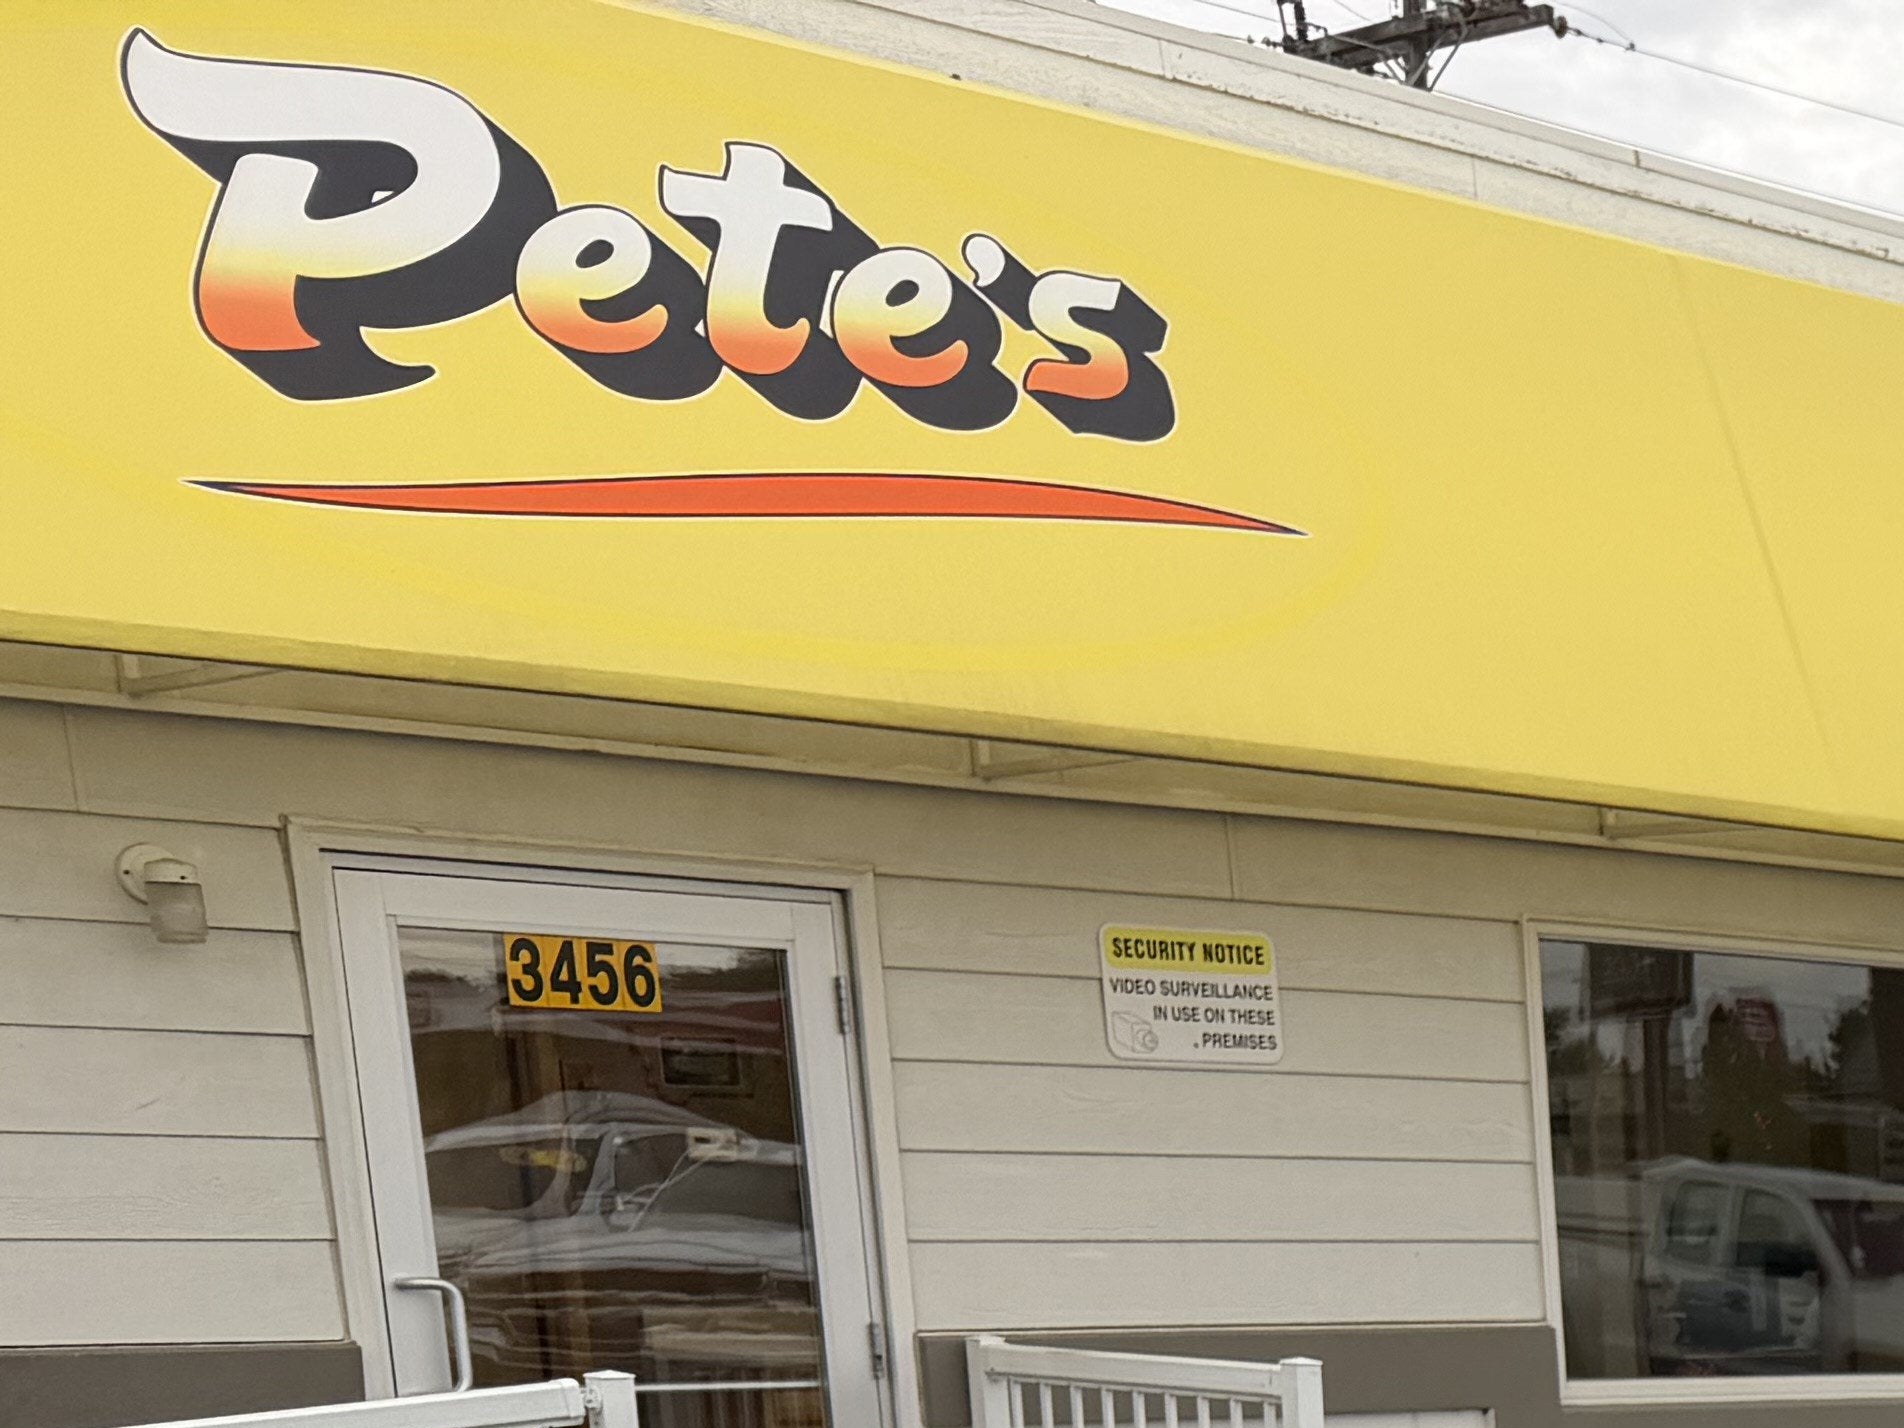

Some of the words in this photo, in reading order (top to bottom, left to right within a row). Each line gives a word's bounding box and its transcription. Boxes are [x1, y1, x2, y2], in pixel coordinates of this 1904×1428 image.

[119, 27, 1172, 440] Pete's
[1112, 937, 1196, 962] SECURITY
[1202, 943, 1265, 966] NOTICE
[510, 938, 656, 1007] 3456
[1109, 977, 1156, 995] VIDEO
[1160, 980, 1273, 1001] SURVEILLANCE
[1153, 1005, 1168, 1021] IN
[1172, 1006, 1200, 1022] USE
[1204, 1007, 1225, 1024] ON
[1229, 1009, 1276, 1026] THESE
[1202, 1031, 1278, 1051] PREMISES
